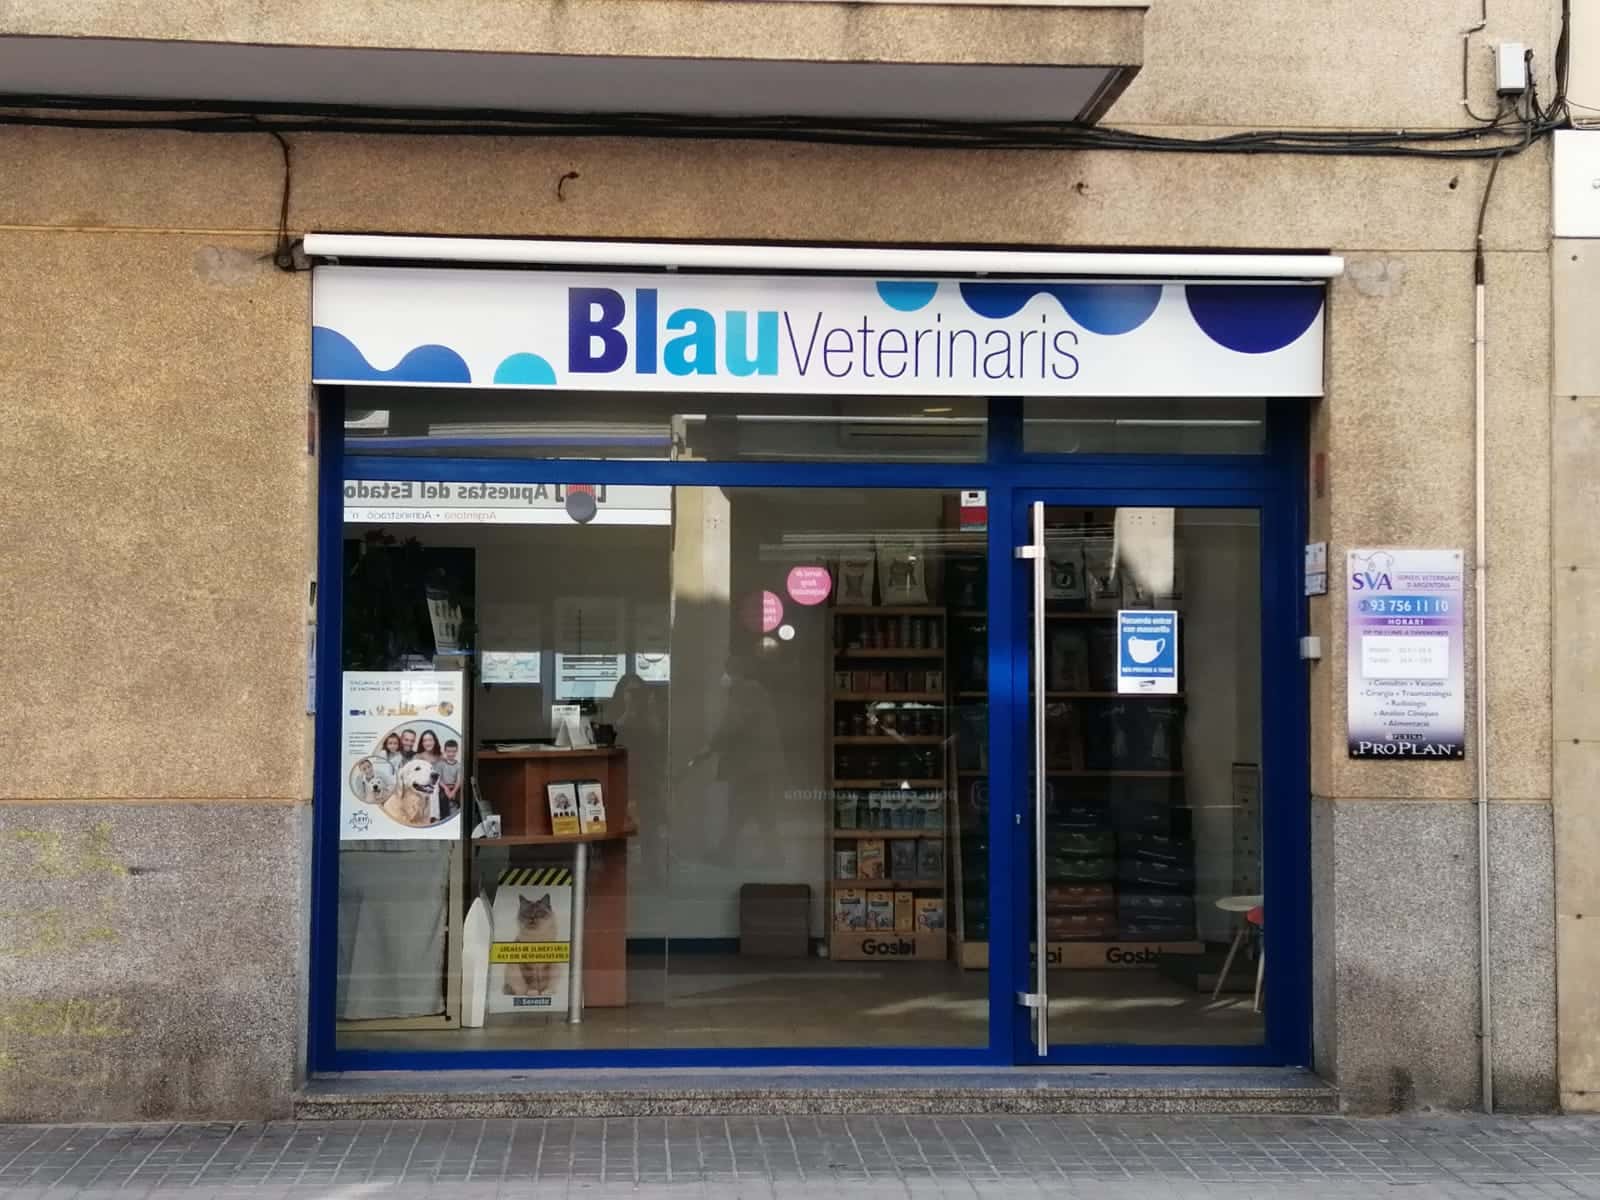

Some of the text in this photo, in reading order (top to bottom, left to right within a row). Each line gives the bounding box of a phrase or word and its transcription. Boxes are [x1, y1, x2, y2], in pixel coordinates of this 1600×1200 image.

[568, 287, 1080, 380] Blau Veterinaris
[1352, 571, 1393, 591] SVA
[1370, 599, 1449, 613] 93 756 11 10
[1387, 618, 1425, 626] HORARI
[861, 938, 916, 955] Gosbi
